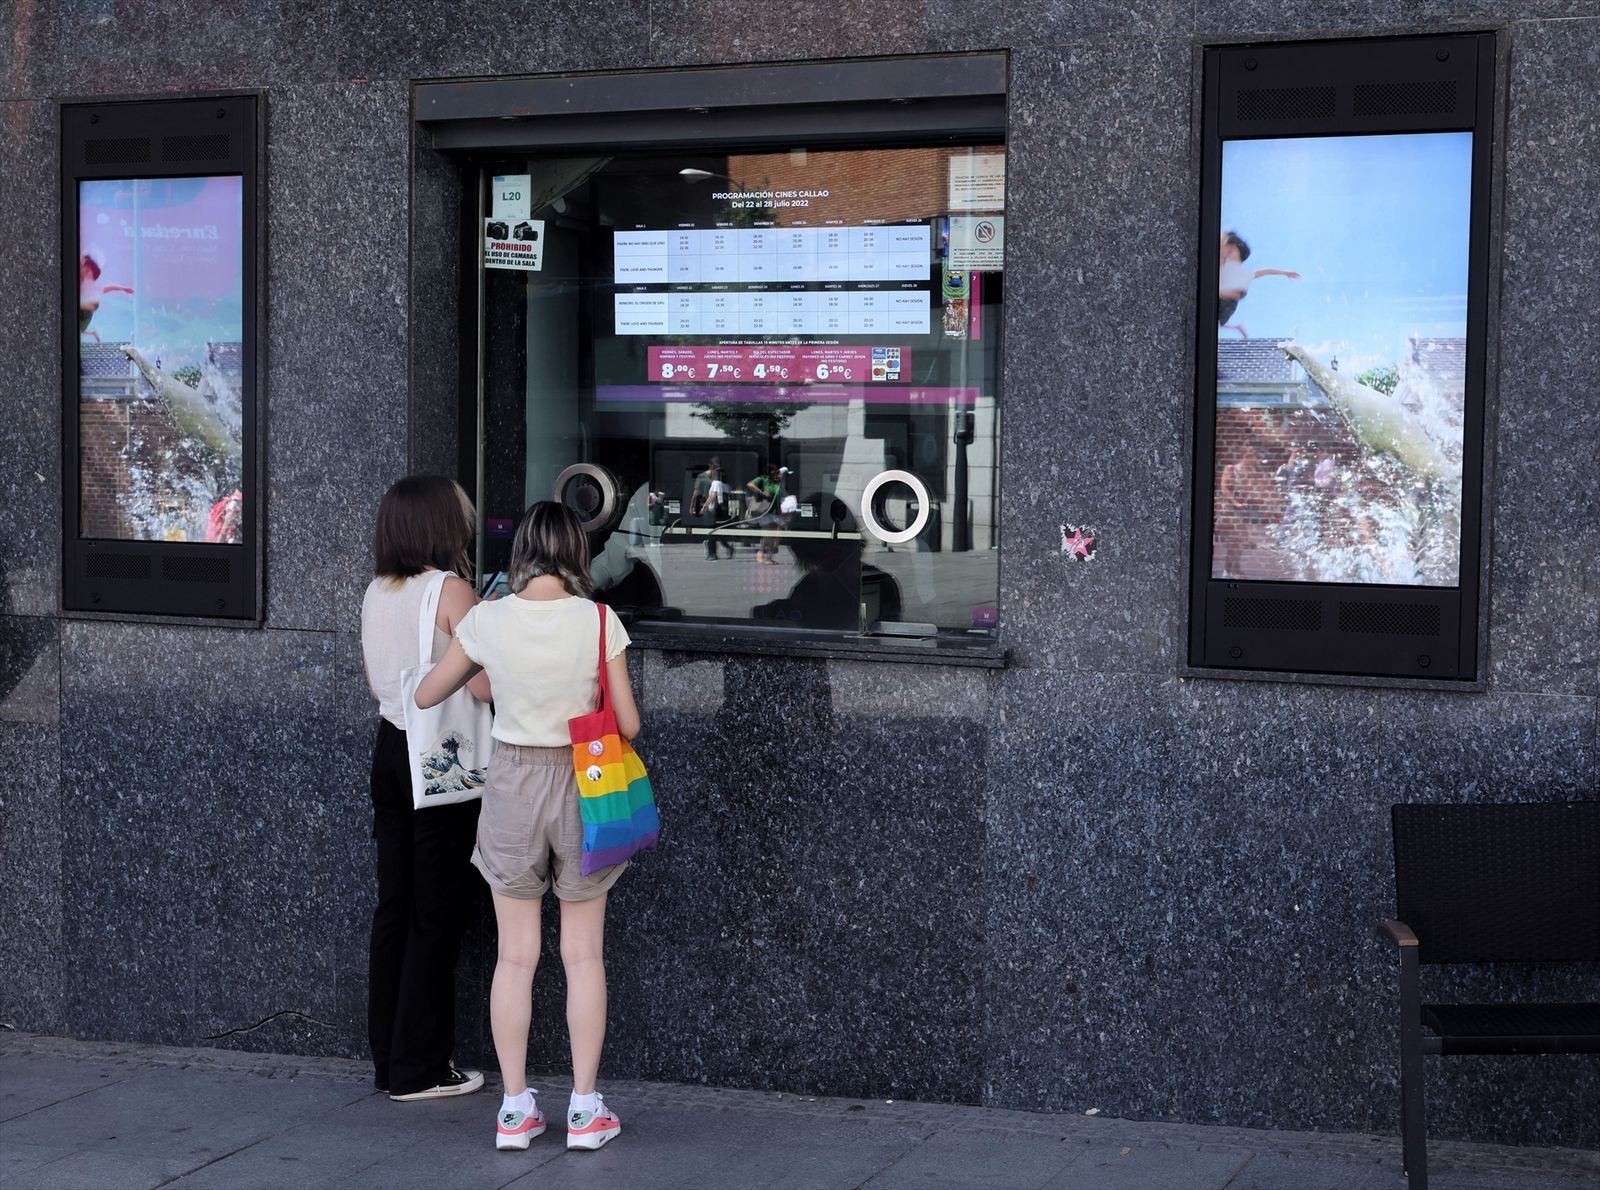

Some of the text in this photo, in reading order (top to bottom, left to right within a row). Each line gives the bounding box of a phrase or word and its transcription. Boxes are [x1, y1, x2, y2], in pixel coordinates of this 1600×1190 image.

[502, 192, 520, 200] L20
[712, 190, 774, 200] PROGRAMACIÓN
[799, 190, 829, 198] CALLAO
[774, 200, 790, 208] julio
[491, 242, 532, 252] PROHIBIDO
